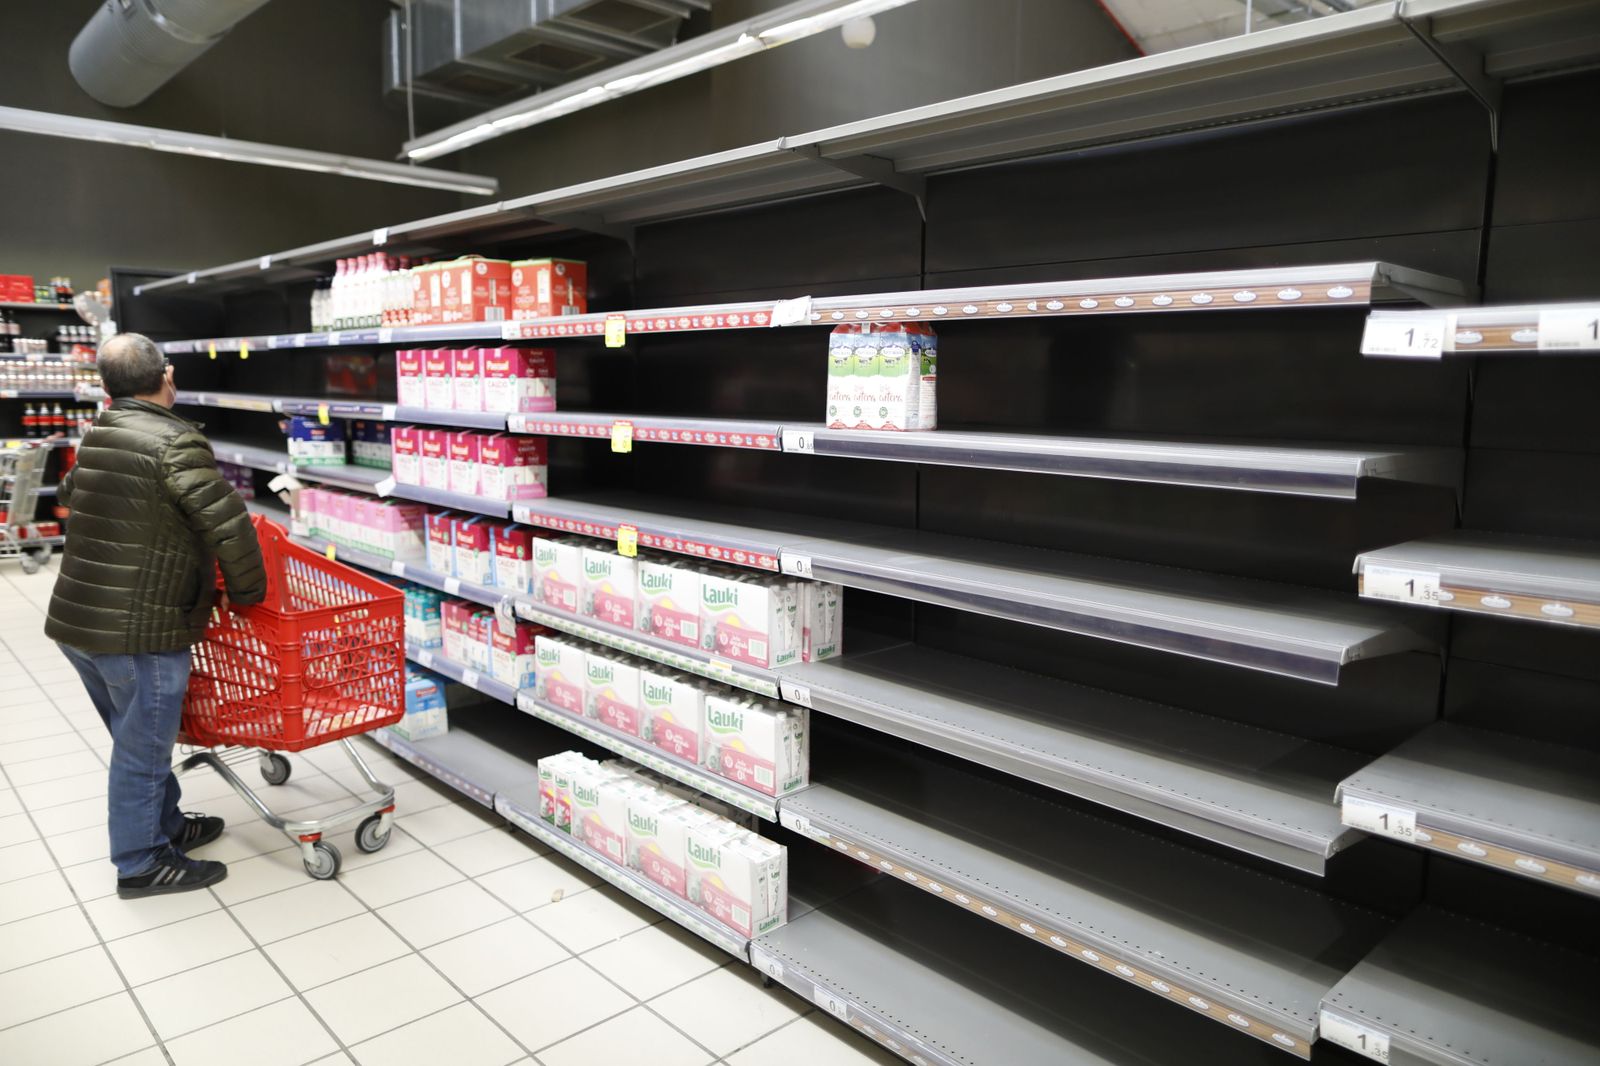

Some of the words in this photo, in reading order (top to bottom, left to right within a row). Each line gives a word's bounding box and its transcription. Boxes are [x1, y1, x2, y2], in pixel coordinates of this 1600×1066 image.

[535, 545, 557, 562] Lauki
[585, 557, 611, 576] Lauki
[641, 569, 672, 589] Lauki
[703, 583, 738, 607] Lauki
[537, 645, 560, 663] Lauki
[818, 644, 835, 656] Lauki
[587, 661, 613, 682] Lauki
[643, 680, 672, 704] Lauki
[708, 705, 743, 731] Lauki
[573, 780, 599, 806] Lauki
[784, 776, 802, 791] Lauki
[628, 808, 658, 836] Lauki
[688, 837, 721, 868] Lauki
[759, 916, 780, 931] Lauki
